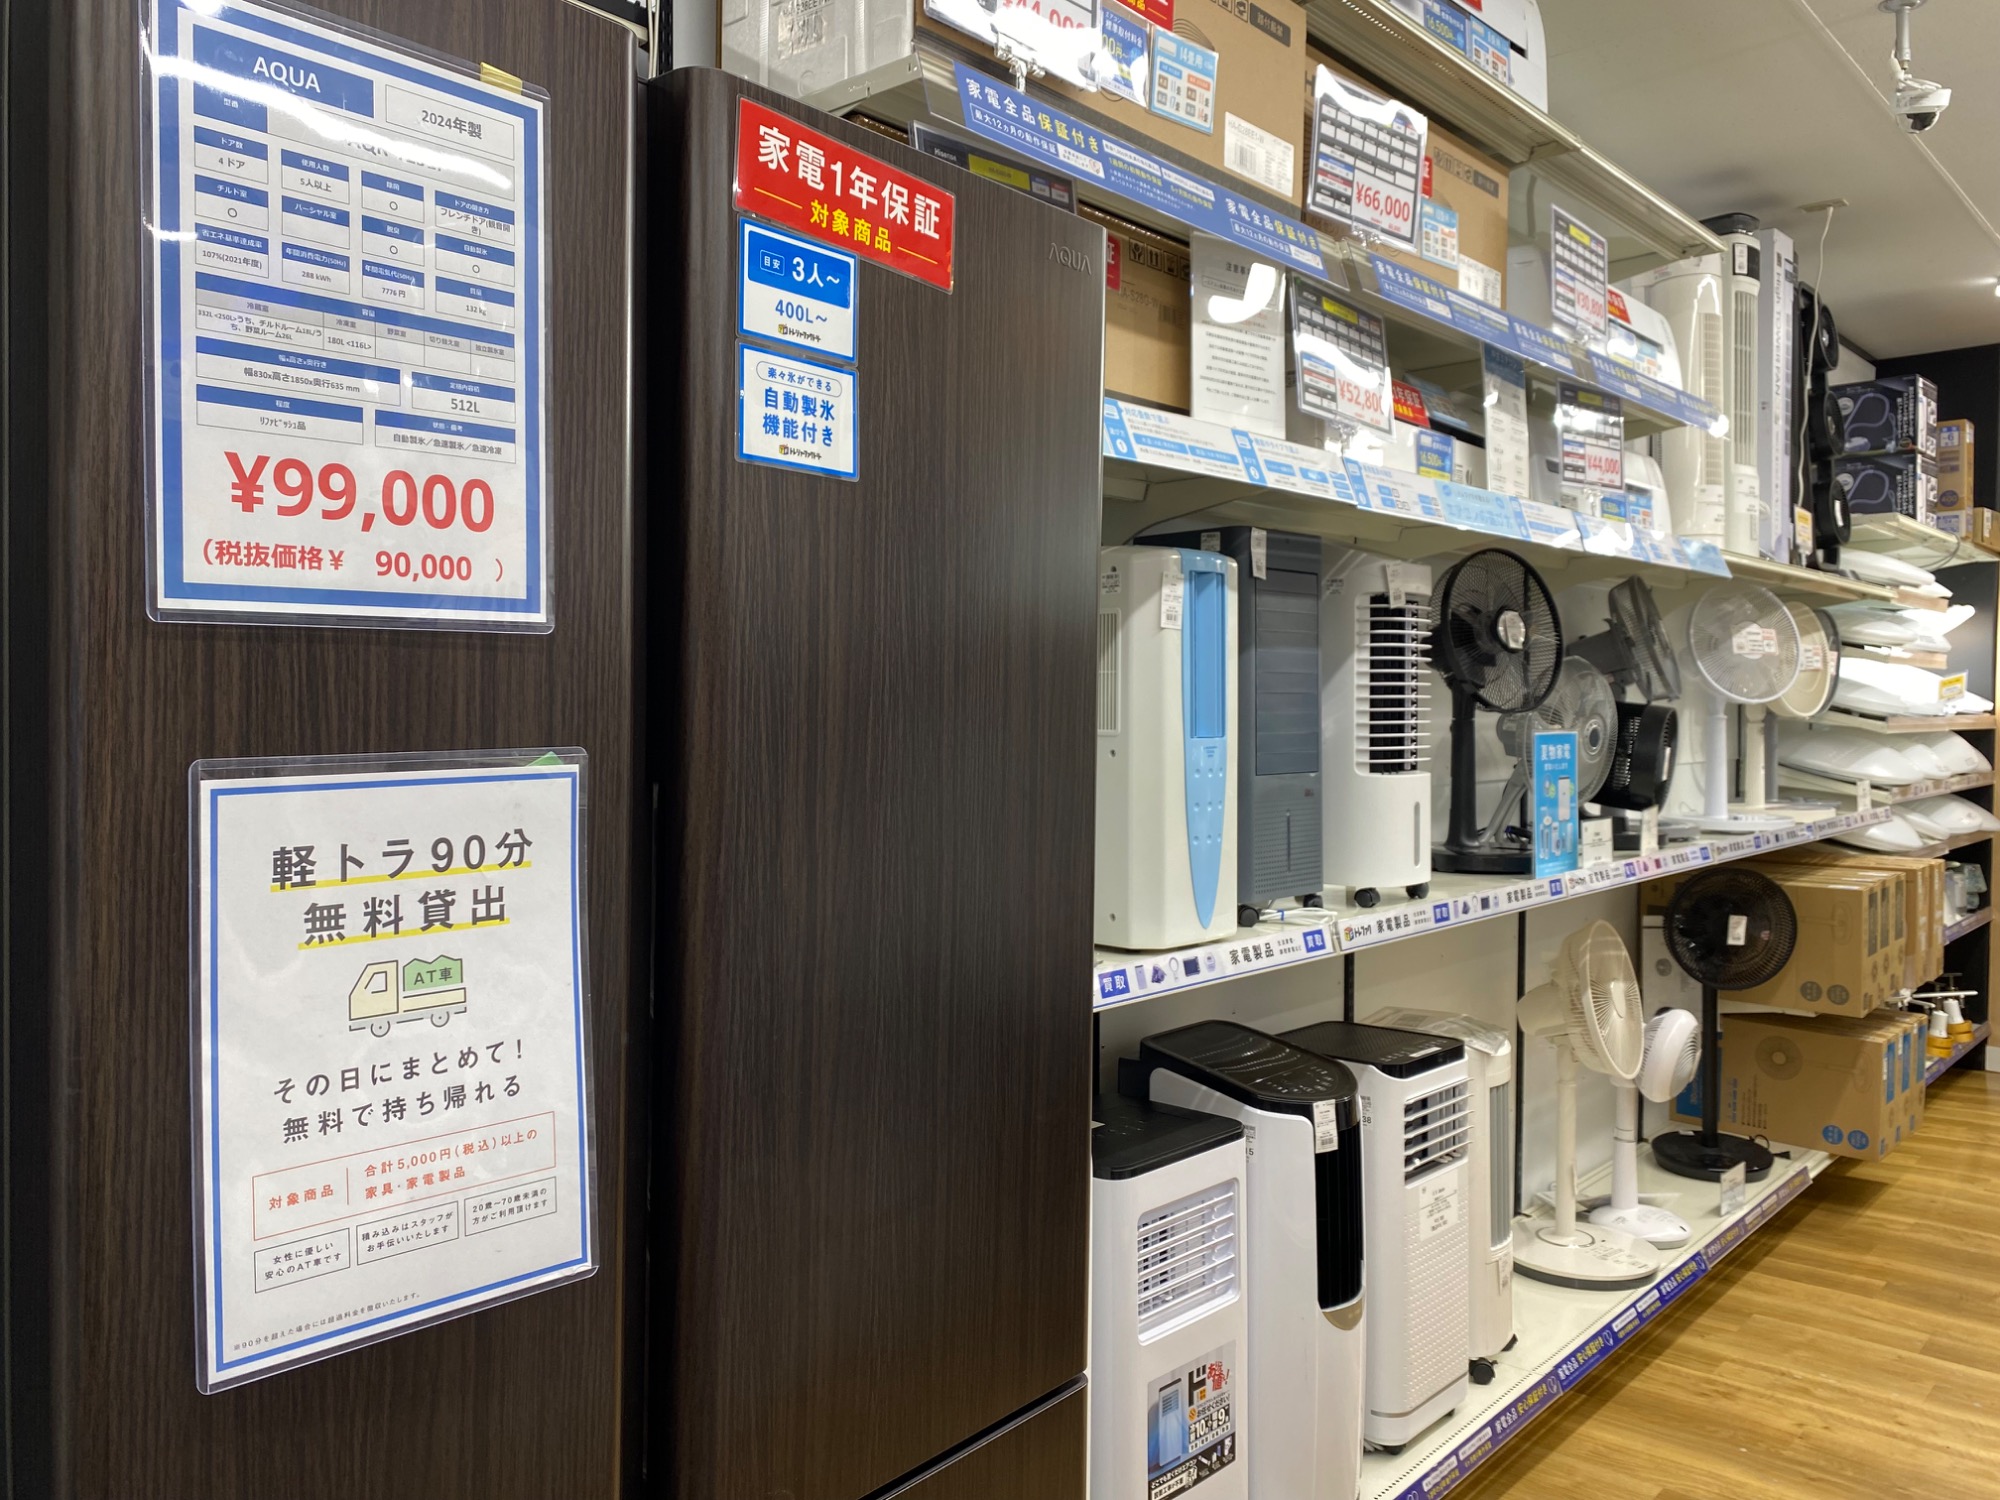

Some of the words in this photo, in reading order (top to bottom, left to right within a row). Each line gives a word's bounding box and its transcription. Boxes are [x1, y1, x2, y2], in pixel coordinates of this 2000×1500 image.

[253, 55, 321, 94] AQUA
[421, 109, 483, 140] 2024年製
[966, 77, 1099, 154] 家電全品保証付き
[221, 136, 244, 150] ドア数
[301, 159, 330, 173] 使用人数
[217, 184, 248, 198] チルド室
[300, 178, 332, 193] 5人以上
[757, 124, 941, 240] 家電1年保証
[454, 200, 489, 215] ドアの開き方
[1356, 181, 1410, 222] ¥66,000
[201, 229, 263, 249] 省エネ基準達成率
[386, 225, 400, 235] 脱臭
[810, 199, 892, 253] 対象商品
[202, 250, 263, 269] 107%(2021年度)
[285, 247, 347, 268] 年間消費電力(50Hz)
[764, 256, 780, 270] 目安
[1048, 242, 1092, 276] AQUA
[1226, 262, 1250, 275] 注意事
[301, 270, 315, 280] 288
[315, 273, 332, 282] kWh
[466, 305, 478, 314] 132
[327, 336, 345, 346] 180L
[346, 340, 372, 351] <116L>
[244, 367, 344, 391] 幅830x高さ1850x奥行635
[345, 385, 360, 393] mm
[768, 367, 832, 392] 楽々氷ができる
[450, 398, 480, 413] 512L
[764, 387, 835, 421] 自動製氷
[1338, 379, 1382, 412] ¥52,80
[762, 413, 833, 447] 機能付き
[224, 450, 495, 533] ¥99,000
[375, 550, 472, 582] 90,000
[271, 828, 533, 890] 軽トラ90分
[303, 884, 506, 946] 無料貸出
[1376, 913, 1411, 934] 家電製品
[1434, 905, 1449, 922] 買取
[1306, 933, 1324, 949] 買取
[413, 966, 453, 986] AT車
[1103, 973, 1127, 995] 買取
[1229, 942, 1275, 966] 家電製品
[274, 1039, 523, 1104] その日にまとめて!
[283, 1075, 521, 1144] 無料で持ち帰れる
[364, 1128, 538, 1178] 合計5,000円(税込)以上の
[268, 1183, 334, 1211] 対象商品
[365, 1166, 466, 1200] 家具・家電製品
[361, 1211, 454, 1242] 積み込みはスタッフが
[472, 1199, 548, 1226] 方がご利用頂けます
[367, 1224, 449, 1253] お手伝いいたします
[265, 1253, 341, 1281] 安心のAT車です
[272, 1242, 334, 1266] 女性に優しい
